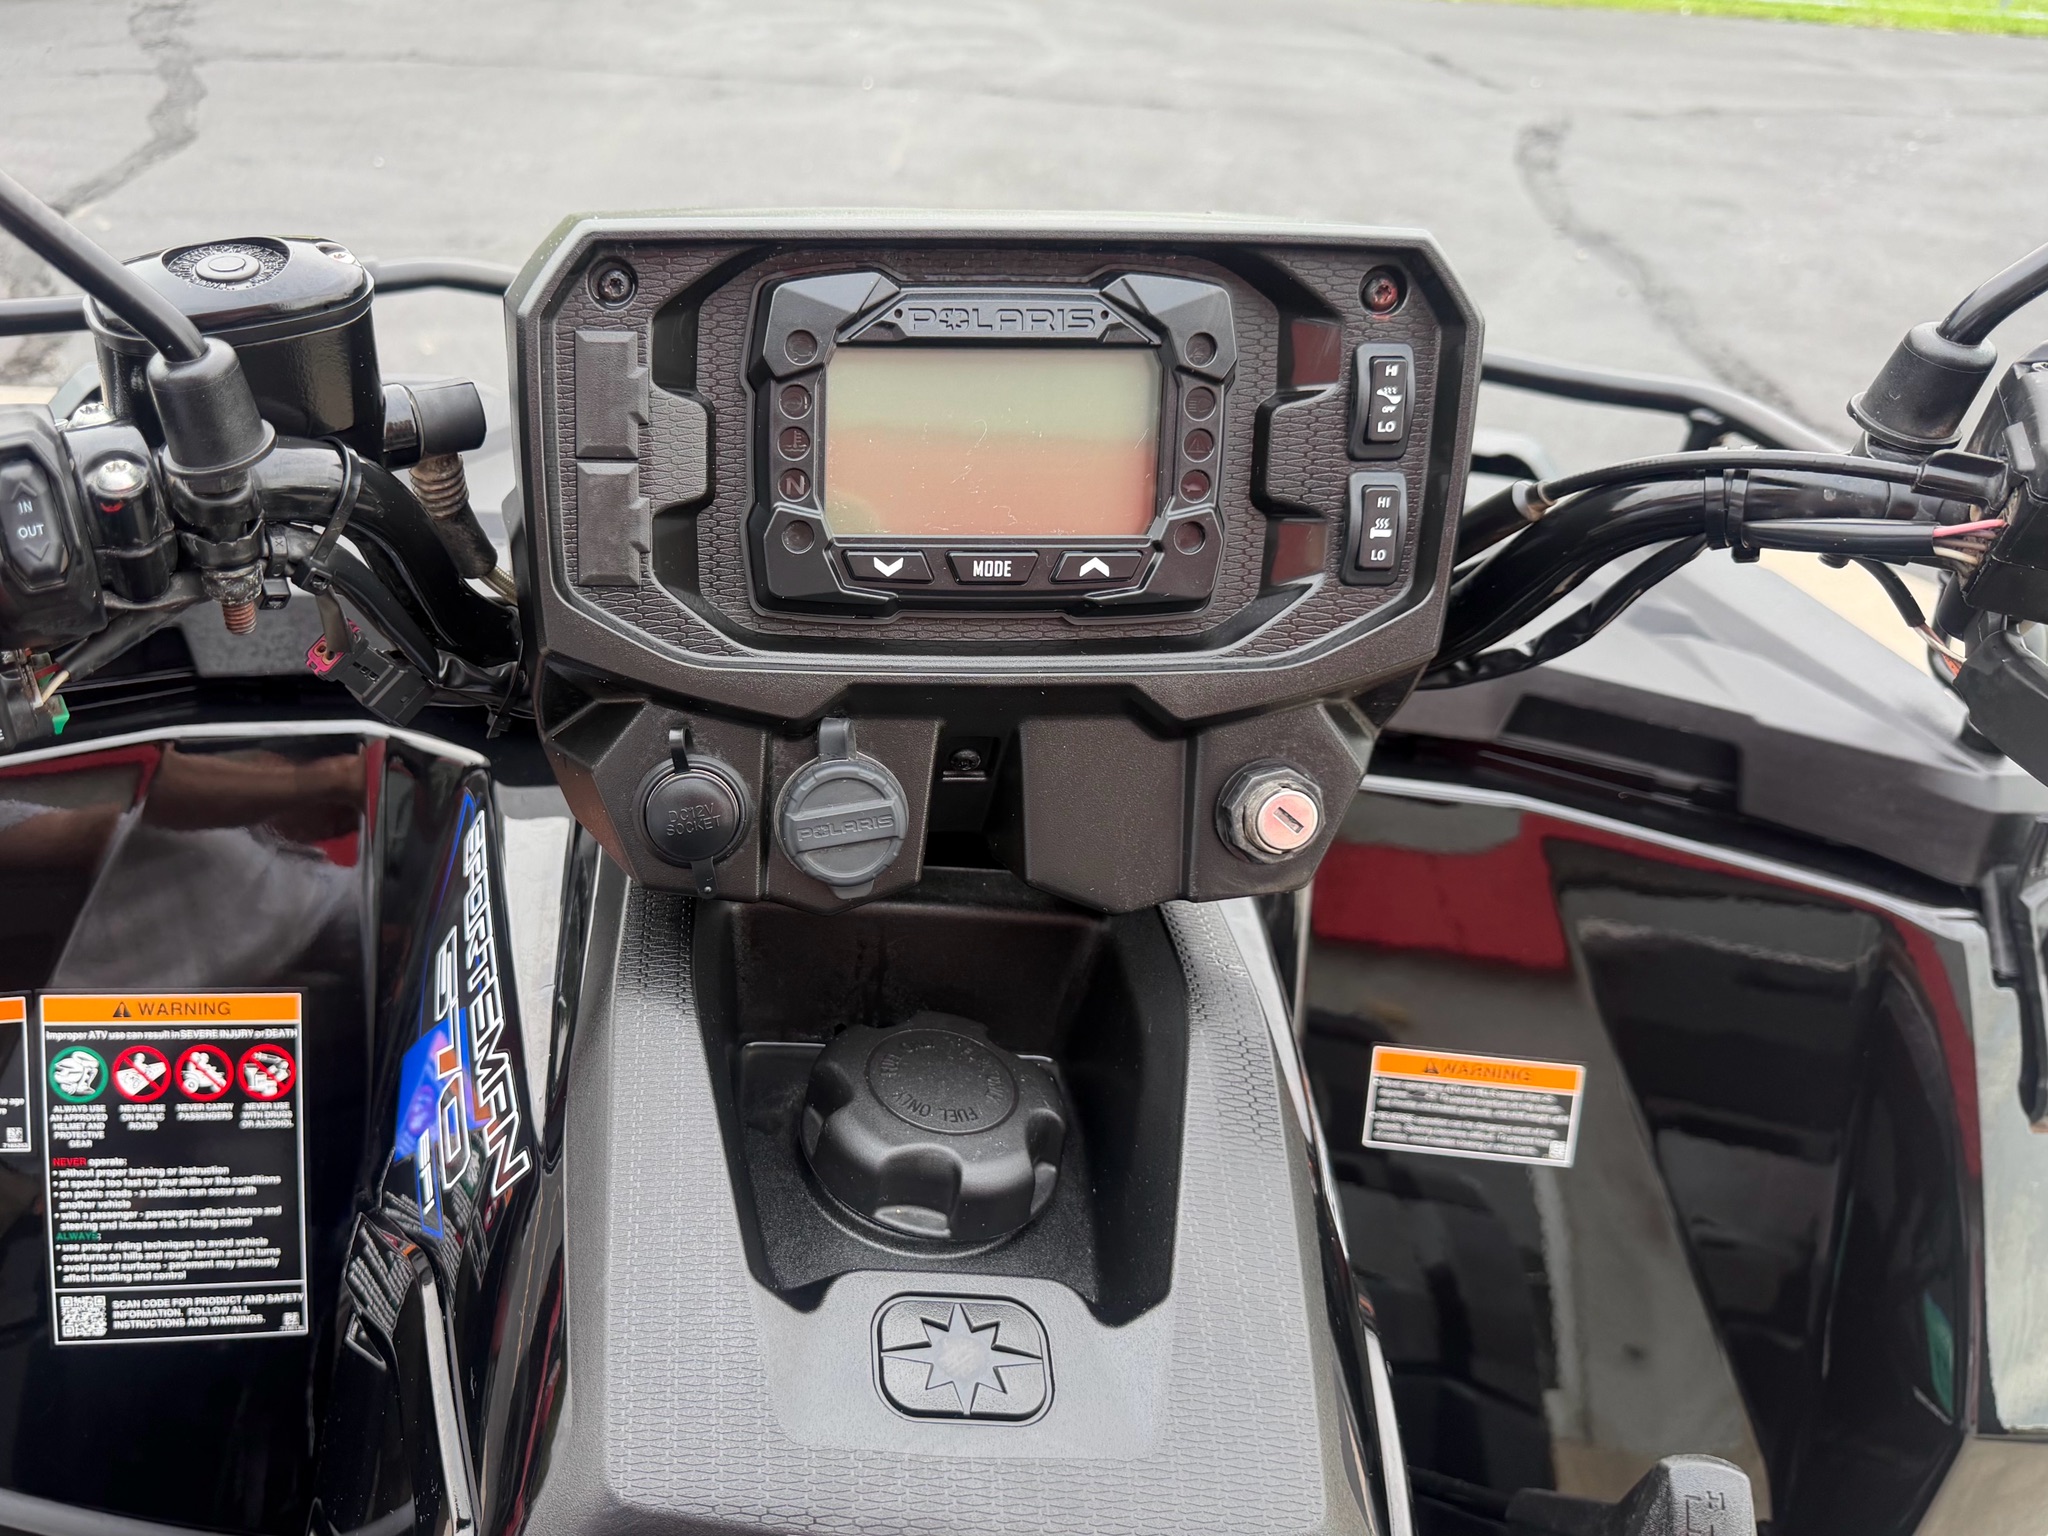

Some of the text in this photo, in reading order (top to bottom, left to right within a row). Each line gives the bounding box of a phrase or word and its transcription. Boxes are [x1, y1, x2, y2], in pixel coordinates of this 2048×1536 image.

[908, 307, 1096, 332] POLARIS
[1385, 364, 1399, 377] HI
[1381, 405, 1397, 414] OFF
[1377, 421, 1396, 433] LO
[786, 475, 805, 495] N
[18, 500, 33, 514] IN
[1377, 496, 1391, 509] HI
[17, 523, 44, 539] OUT
[1370, 550, 1387, 562] LO
[973, 560, 1012, 577] MODE
[666, 814, 721, 836] SOCKET
[797, 814, 894, 842] POLARIS
[138, 1001, 231, 1016] WARNING
[463, 810, 530, 1198] SPORTSMAN
[46, 1030, 87, 1043] Improper
[88, 1029, 108, 1040] ATV
[109, 1031, 126, 1040] use
[126, 1031, 143, 1040] can
[144, 1029, 170, 1040] result
[170, 1029, 180, 1039] in
[180, 1028, 218, 1040] SEVERE
[219, 1028, 254, 1039] INJURY
[265, 1028, 298, 1038] DEATH
[1443, 1063, 1531, 1081] WARNING
[52, 1104, 107, 1113] ALWAYS USE
[118, 1103, 167, 1113] NEVER USE
[175, 1102, 235, 1112] NEVER CARRY
[242, 1101, 291, 1111] NEVER USE
[49, 1113, 109, 1122] AN APPROVED
[119, 1112, 166, 1122] ON PUBLIC
[176, 1111, 234, 1121] PASSENGERS
[240, 1110, 294, 1120] WITH DRUGS
[938, 1106, 979, 1123] FUEL
[52, 1122, 106, 1131] HELMET AND
[127, 1121, 159, 1131] ROADS
[239, 1119, 294, 1130] OR ALCOHOL
[53, 1131, 106, 1140] PROTECTIVE
[68, 1139, 93, 1149] GEAR
[52, 1157, 87, 1167] NEVER
[58, 1165, 230, 1180] without proper training or instruction
[419, 1128, 435, 1216] EFI
[58, 1199, 132, 1210] another vehicle
[59, 1220, 99, 1232] steering
[99, 1220, 118, 1230] and
[118, 1220, 159, 1230] increase
[159, 1218, 178, 1230] risk
[189, 1217, 219, 1231] losing
[219, 1216, 254, 1228] control
[61, 1236, 269, 1253] use proper riding techniques to avoid vehicle
[61, 1247, 282, 1263] overturns on hills and rough terrain and in turns
[62, 1270, 187, 1284] affect handling and control
[112, 1292, 304, 1310] SCAN CODE FOR PRODUCT AND SAFETY
[186, 1306, 230, 1317] FOLLOW
[230, 1305, 251, 1315] ALL
[113, 1318, 186, 1330] INSTRUCTIONS
[186, 1316, 209, 1328] AND
